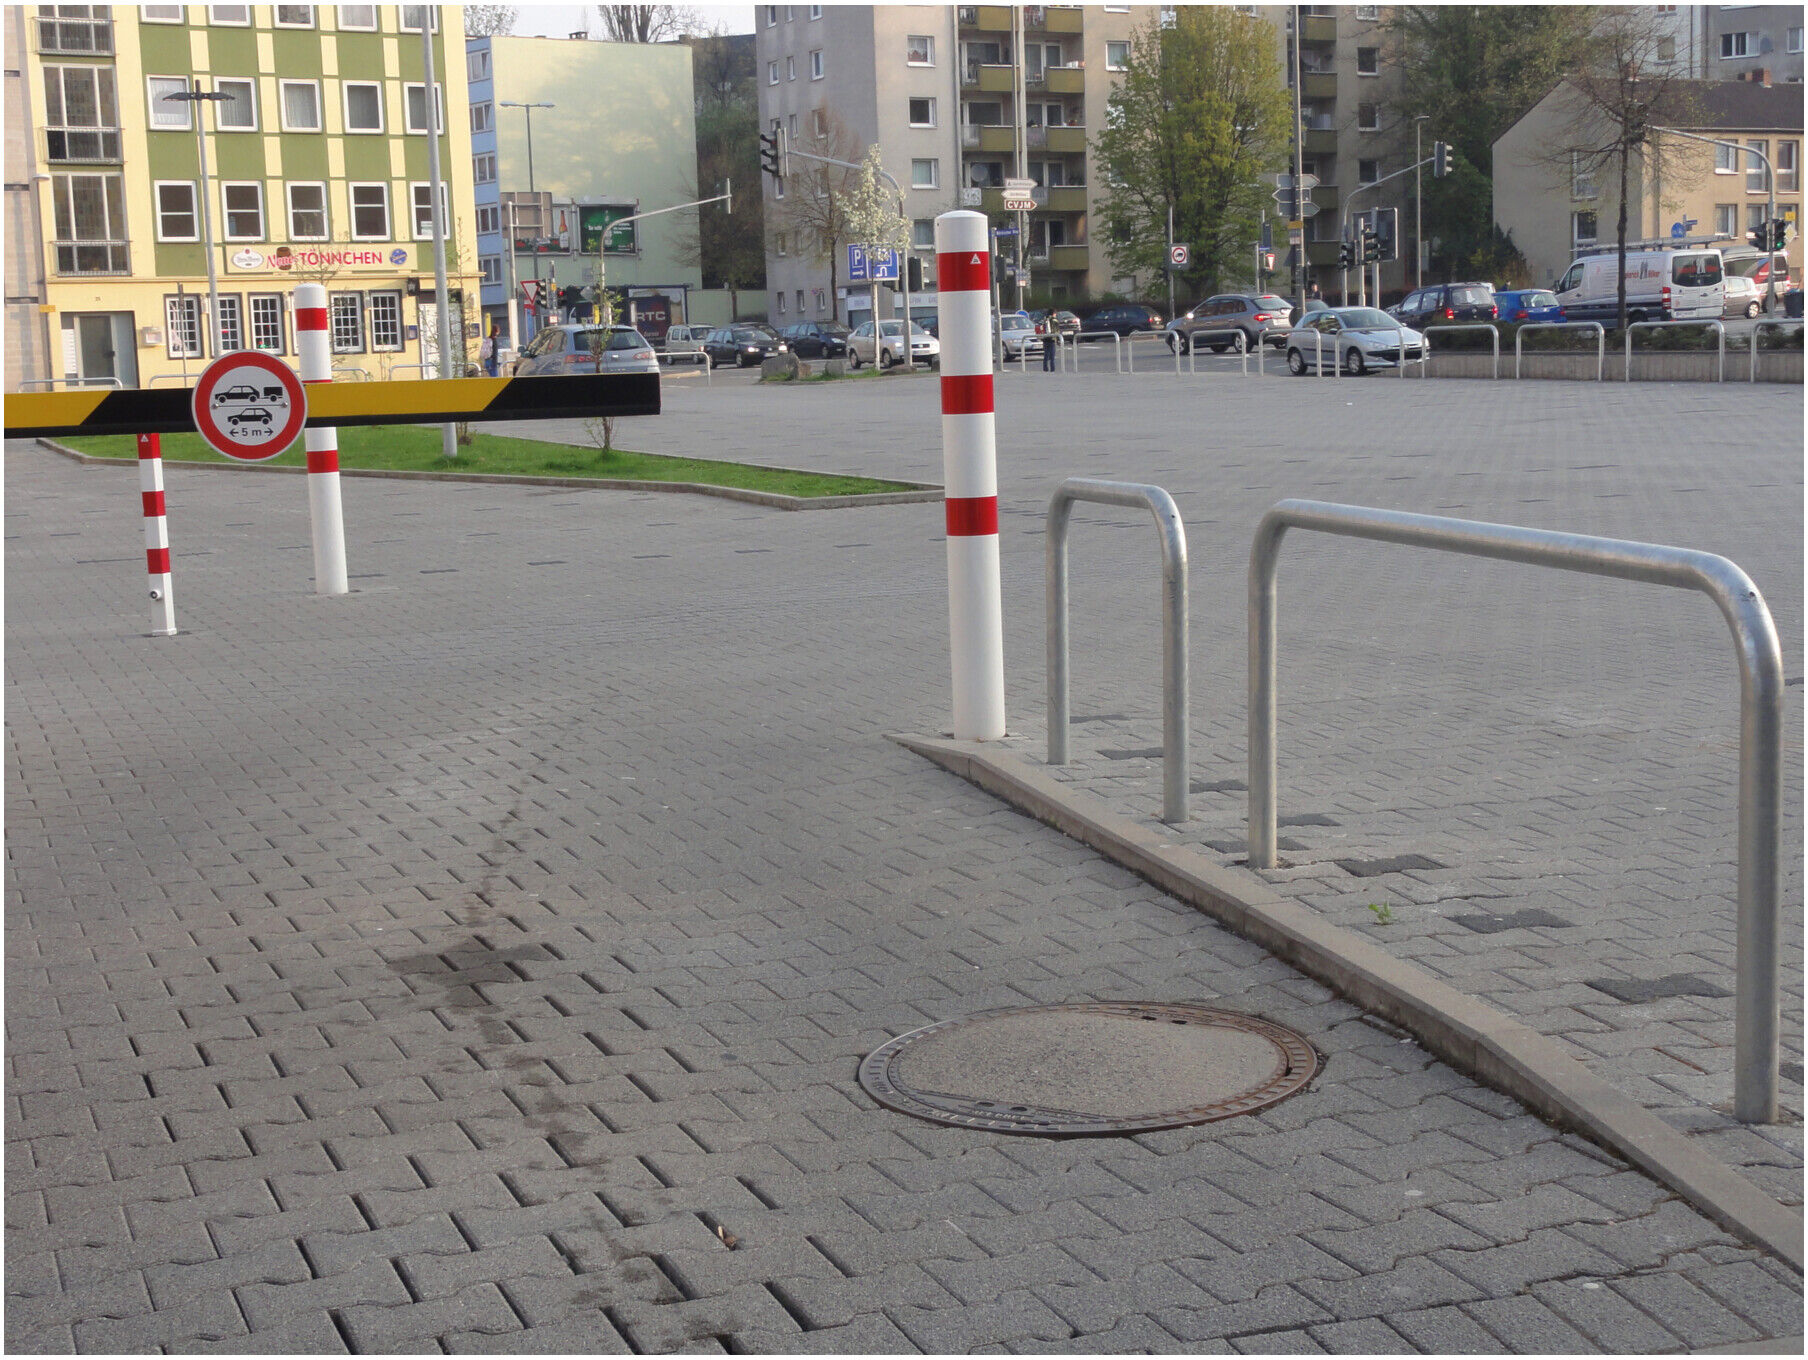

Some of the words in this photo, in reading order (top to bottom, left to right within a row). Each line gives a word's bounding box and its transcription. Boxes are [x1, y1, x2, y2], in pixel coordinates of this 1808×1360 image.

[1007, 201, 1031, 209] CVJM
[300, 249, 382, 265] TÖNNCHEN
[854, 249, 861, 265] P
[241, 428, 248, 436] 5
